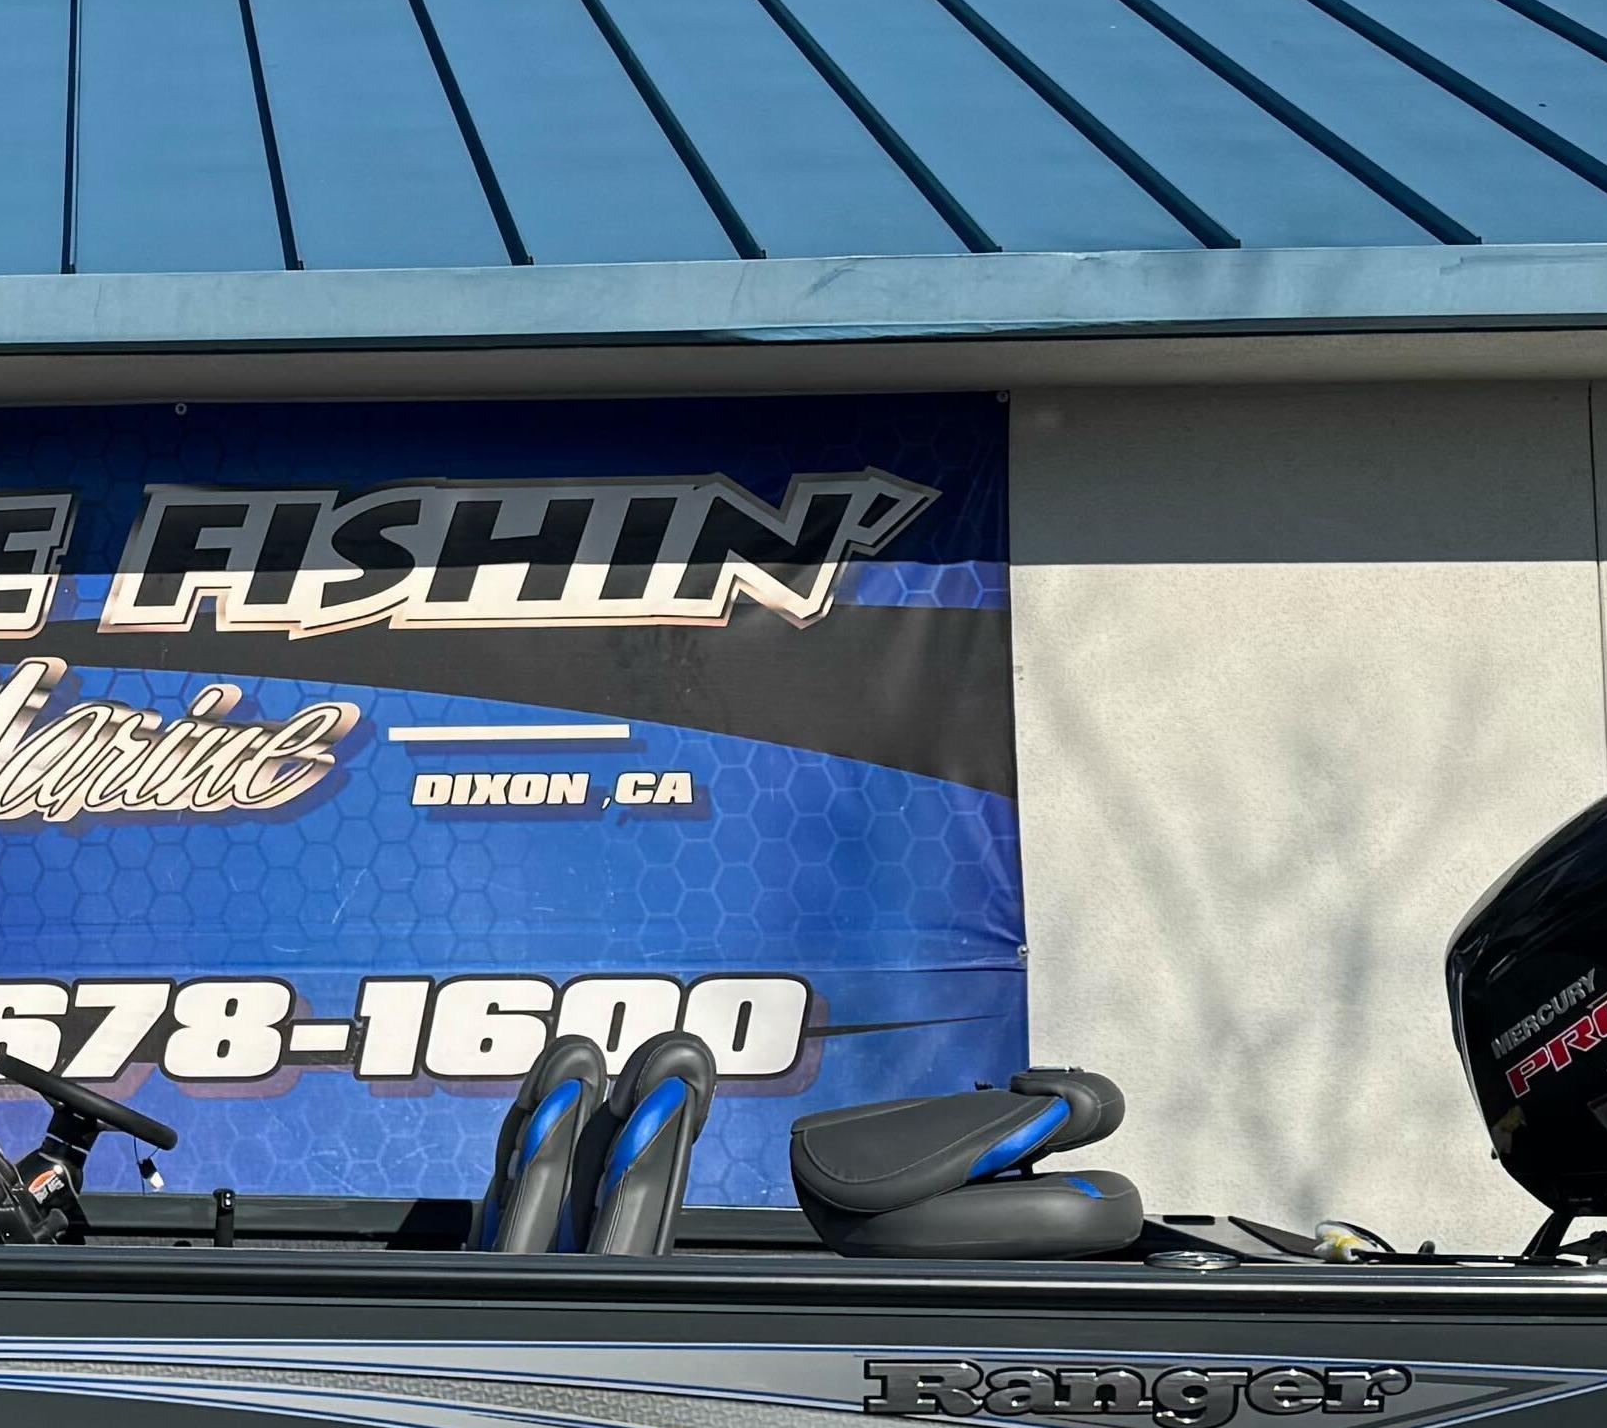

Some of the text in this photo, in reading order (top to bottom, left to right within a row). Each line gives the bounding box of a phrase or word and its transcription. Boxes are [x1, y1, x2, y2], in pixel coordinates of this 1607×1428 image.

[97, 467, 942, 640] FISHIN'
[410, 773, 590, 806] DIXON
[1490, 967, 1596, 1060] MERCURY
